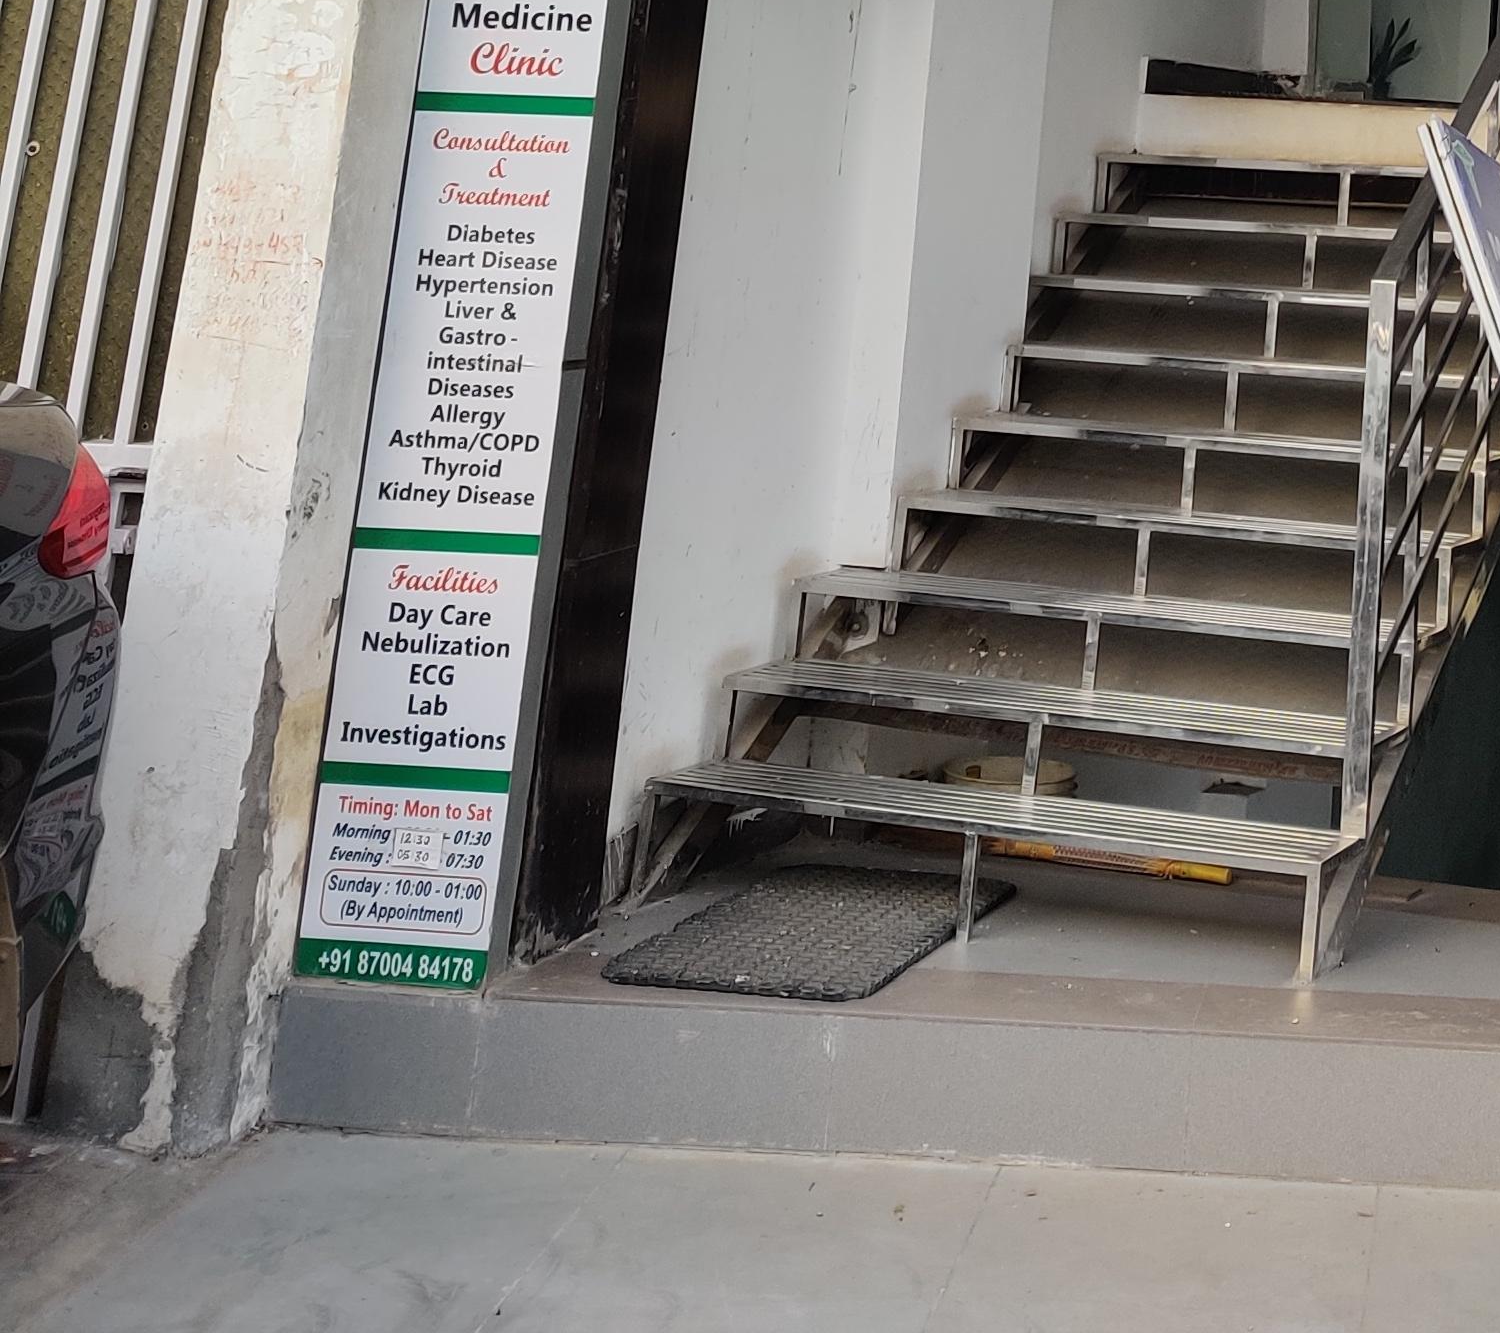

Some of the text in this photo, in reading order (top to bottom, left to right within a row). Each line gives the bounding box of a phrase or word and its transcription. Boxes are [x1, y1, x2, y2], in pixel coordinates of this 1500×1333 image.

[452, 3, 593, 32] Medicine
[470, 42, 564, 77] Clinic
[432, 128, 570, 154] Consultation
[488, 157, 507, 179] &
[438, 182, 551, 208] Treatment
[447, 224, 536, 245] Diabetes
[417, 249, 558, 271] Heart Disease
[415, 274, 554, 298] Hypertension
[444, 300, 517, 321] Liver &
[439, 326, 506, 346] Gastro
[426, 350, 524, 373] intestinal
[427, 378, 515, 399] Diseases
[430, 404, 506, 430] Allergy
[388, 429, 541, 453] Asthma/COPD
[421, 456, 503, 481] Thyroid
[377, 482, 535, 508] Kidney Disease
[387, 564, 499, 595] Facilities
[388, 602, 492, 628] Day Care
[361, 631, 510, 659] Nebulization
[408, 664, 455, 687] ECG
[407, 694, 448, 717] Lab
[340, 721, 507, 752] Investigations
[339, 796, 493, 822] Timing: Mon to Sat
[332, 822, 492, 847] Morning 01:30
[329, 846, 384, 867] Evening
[445, 853, 484, 870] 07:30
[327, 874, 382, 898] Sunday
[395, 879, 432, 897] 10:00
[444, 882, 483, 901] 01:00
[340, 899, 464, 928] (By Appointment)
[318, 948, 474, 983] +91 87004 84178
